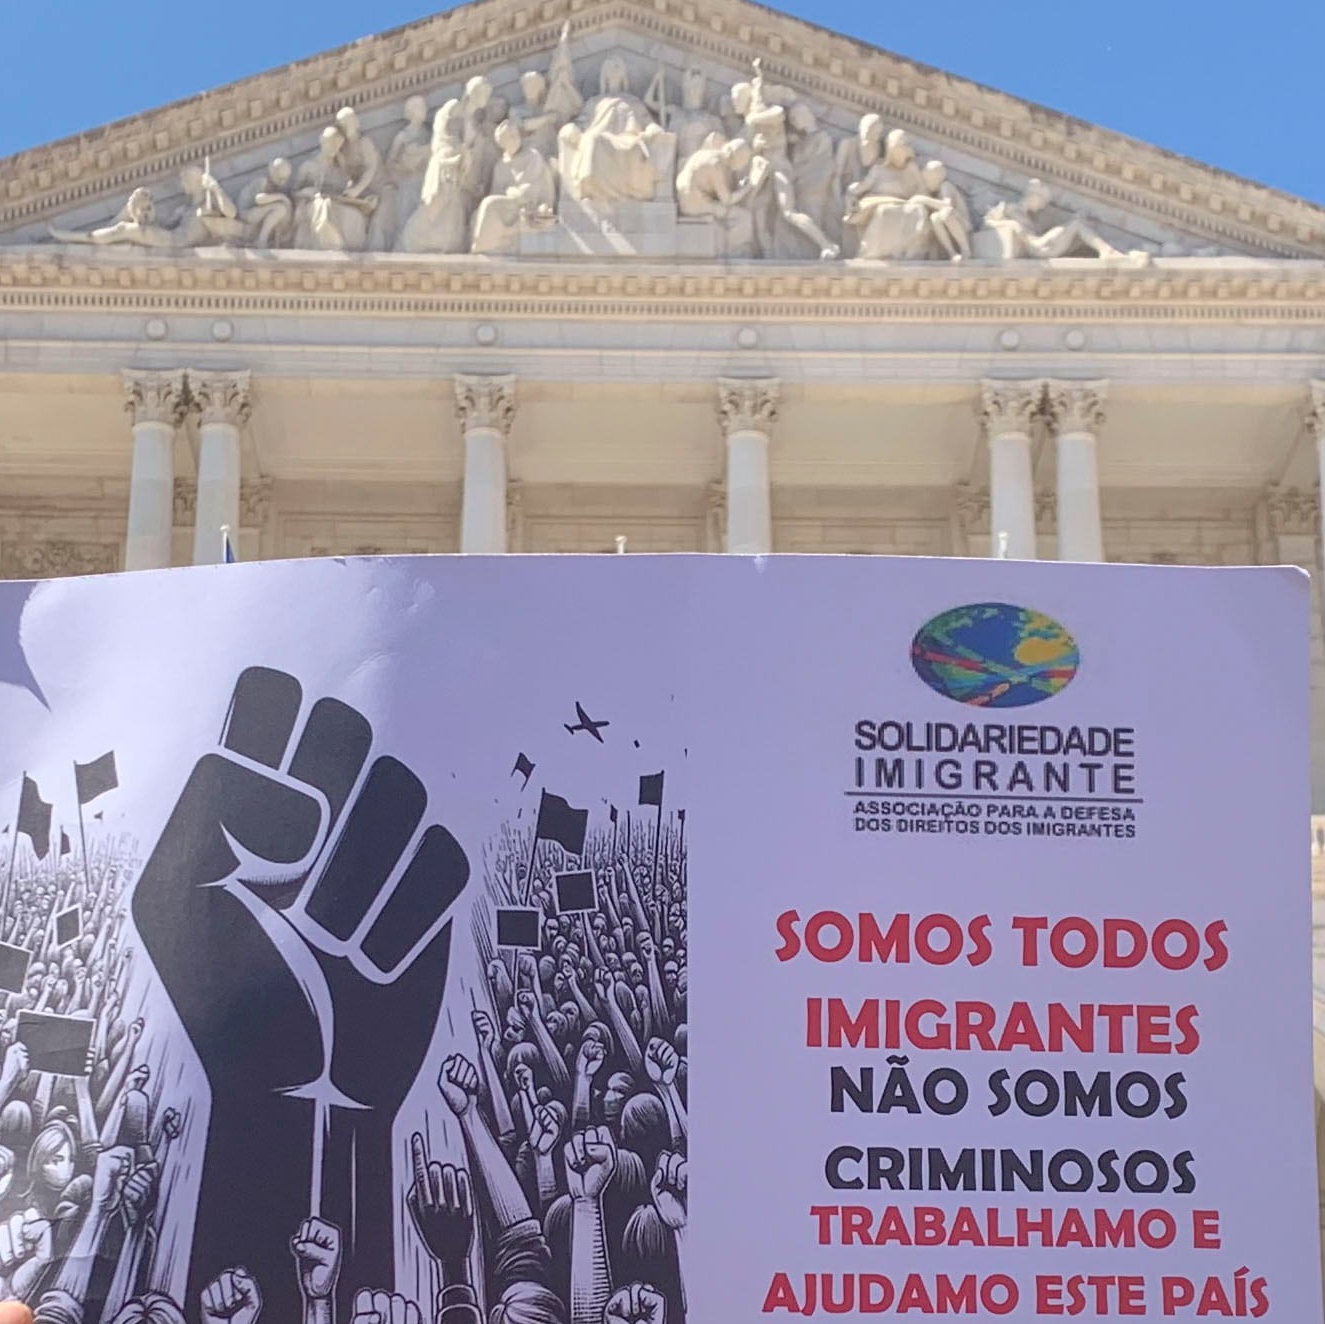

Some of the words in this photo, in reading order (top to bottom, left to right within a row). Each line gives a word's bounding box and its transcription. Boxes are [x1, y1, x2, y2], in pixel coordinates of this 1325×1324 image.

[855, 719, 1135, 757] SOLIDARIEDADE
[855, 757, 1136, 794] IMIGRANTE
[853, 800, 982, 820] ASSOCIAÇÃO
[987, 803, 1038, 819] PARA
[1043, 805, 1057, 820] A
[1061, 806, 1136, 821] DEFESA
[855, 818, 892, 833] DOS
[897, 818, 980, 834] DIREITOS
[984, 821, 1023, 836] DOS
[1027, 822, 1136, 838] IMIGRANTES
[775, 909, 993, 967] SOMOS
[1012, 916, 1229, 972] TODOS
[806, 997, 1200, 1055] IMIGRANTES
[830, 1054, 969, 1116] NÃO
[988, 1068, 1188, 1120] SOMOS
[824, 1145, 1197, 1194] CRIMINOSOS
[810, 1205, 1177, 1250] TRABALHAMO
[1193, 1210, 1221, 1250] E
[761, 1272, 1020, 1317] AJUDAMO
[1035, 1274, 1147, 1316] ESTE
[1161, 1265, 1270, 1318] PAÍS
